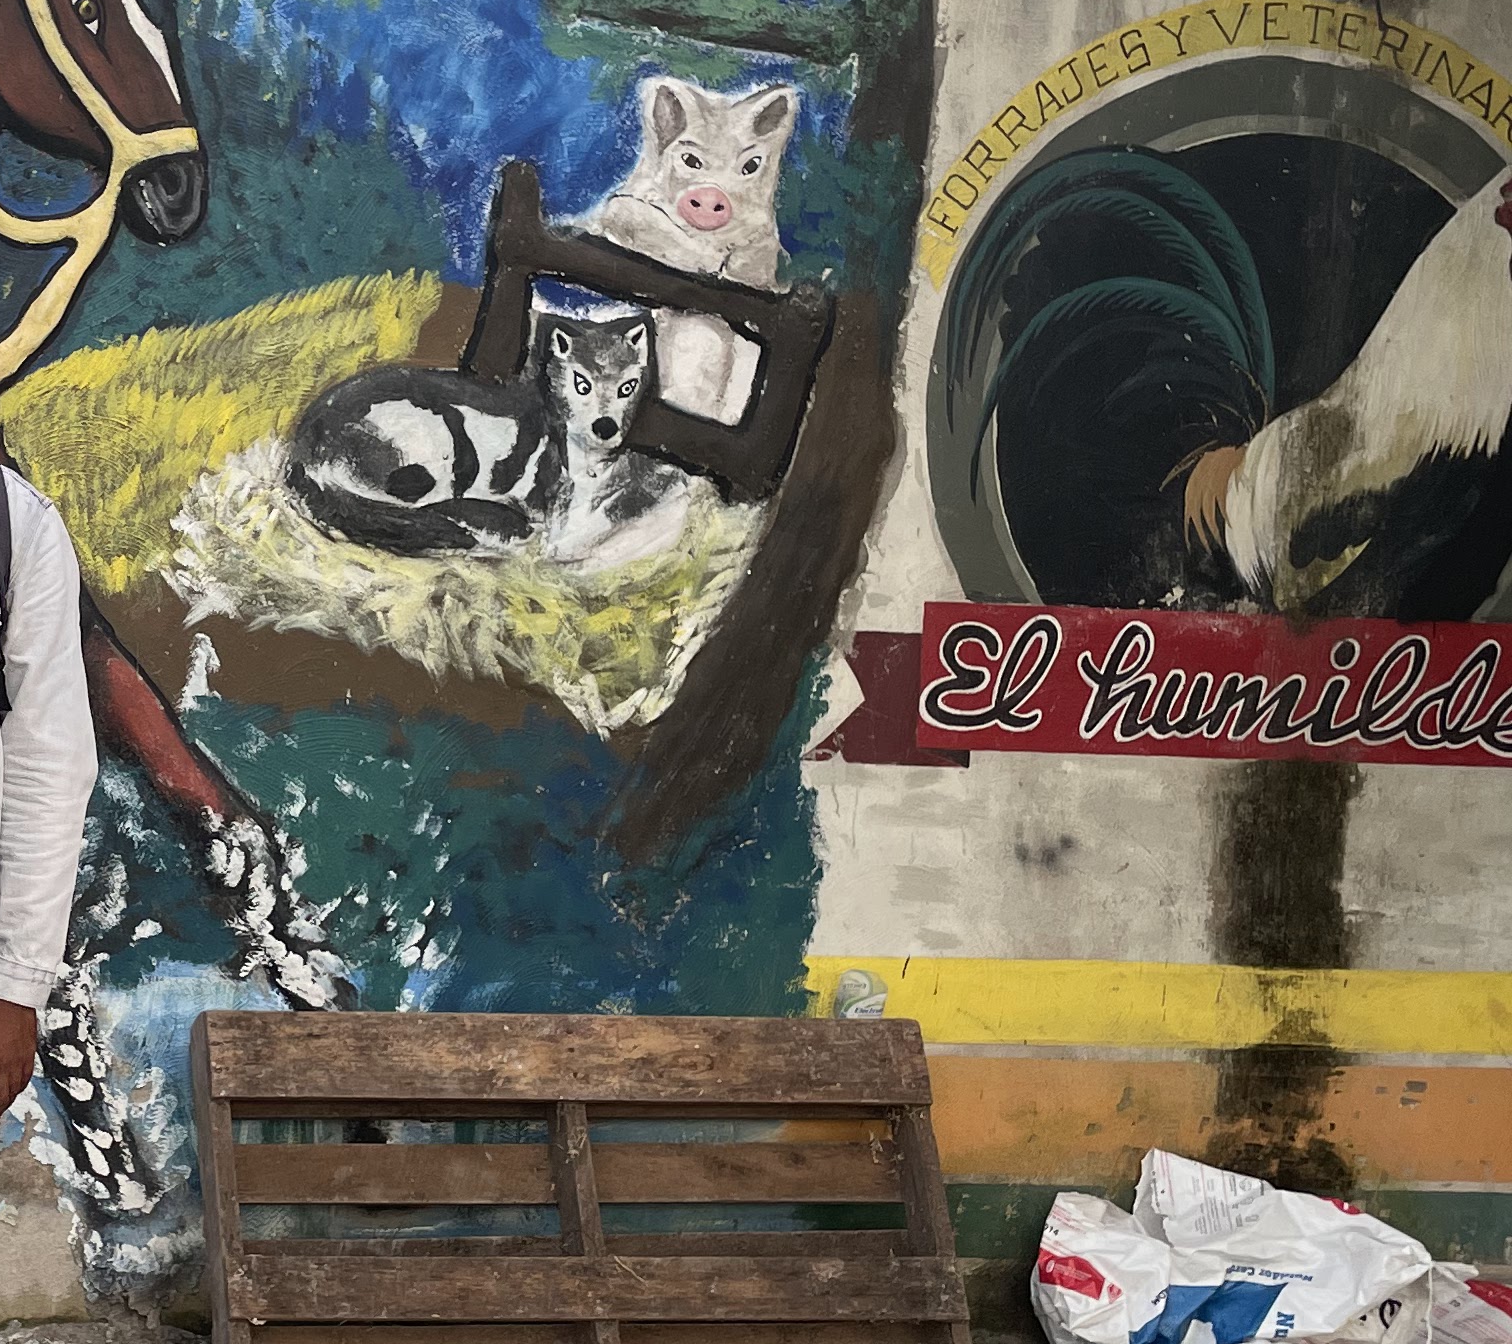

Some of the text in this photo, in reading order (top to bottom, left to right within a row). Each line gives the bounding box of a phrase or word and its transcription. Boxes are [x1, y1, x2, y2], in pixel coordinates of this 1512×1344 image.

[927, 29, 1151, 238] FORRAJES
[1155, 14, 1191, 56] Y
[919, 613, 1063, 732] El
